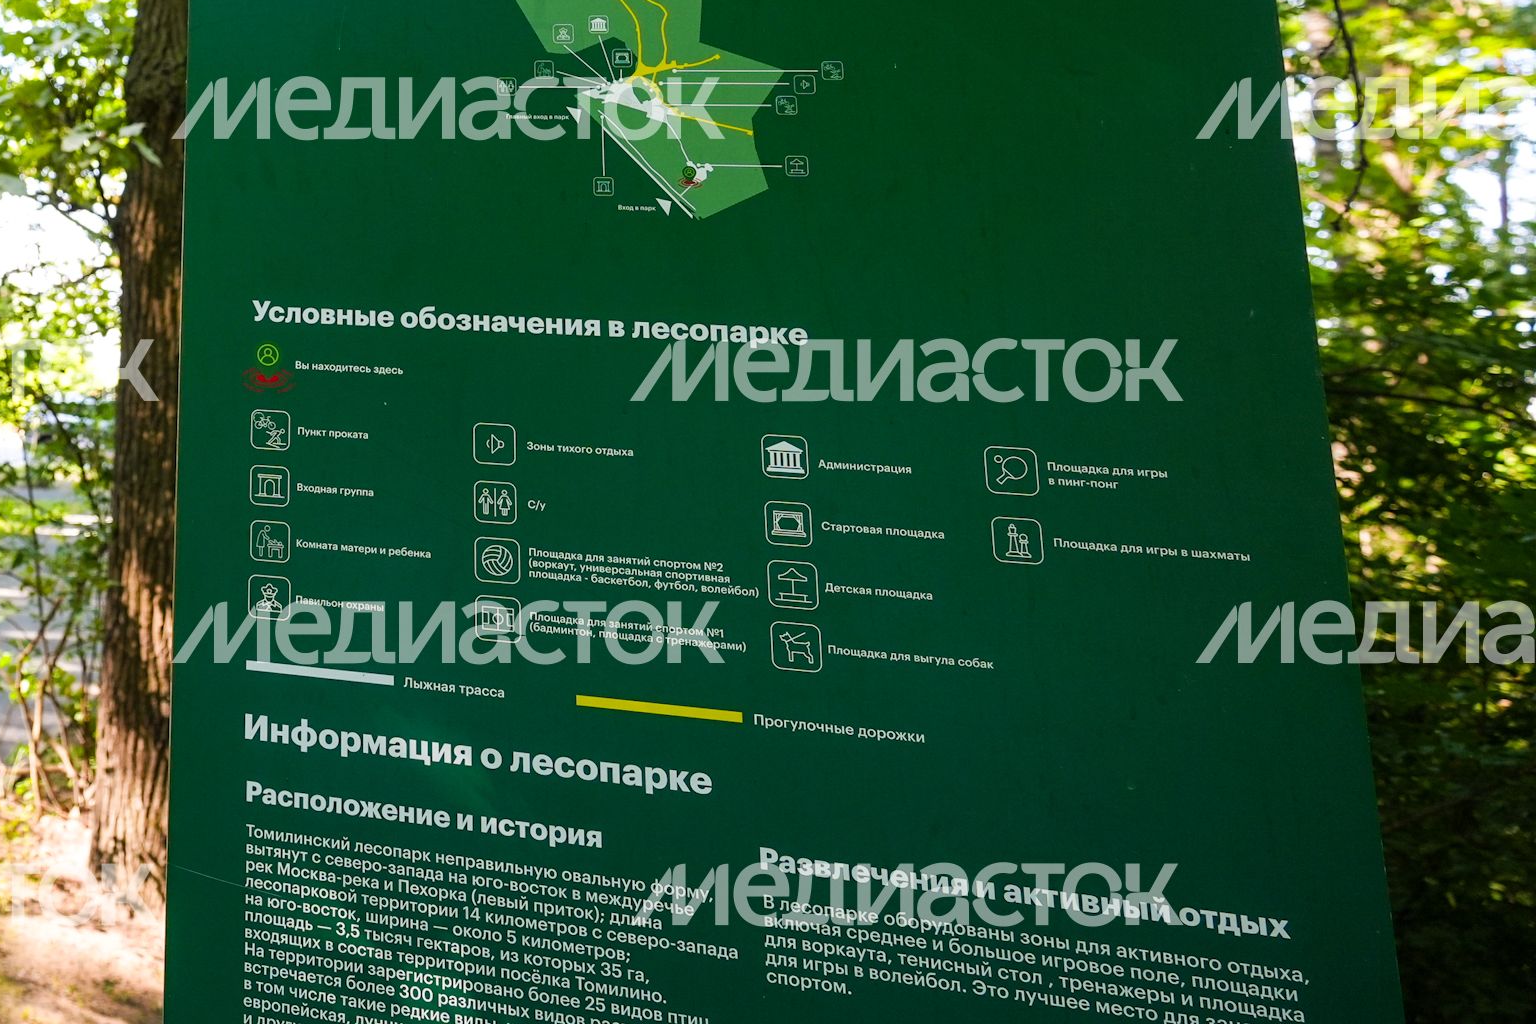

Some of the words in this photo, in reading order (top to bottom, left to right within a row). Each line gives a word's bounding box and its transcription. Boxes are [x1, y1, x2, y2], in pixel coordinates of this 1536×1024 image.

[252, 299, 394, 328] Условные
[400, 306, 601, 336] обозначения
[608, 320, 625, 337] в
[631, 321, 808, 346] лесопарке
[295, 360, 310, 370] Вы
[311, 363, 371, 373] находитесь
[373, 366, 404, 375] здесь
[297, 426, 327, 437] Пункт
[328, 430, 369, 440] проката
[526, 441, 555, 452] Зоны
[556, 445, 593, 454] тихого
[594, 447, 634, 457] отдыха
[818, 459, 912, 474] Администрация
[1046, 461, 1109, 475] Площадка
[1111, 467, 1134, 476] для
[1136, 469, 1168, 479] игры
[296, 482, 338, 494] Входная
[339, 487, 374, 497] группа
[1048, 477, 1055, 485] в
[1057, 478, 1119, 489] пинг-понг
[527, 499, 546, 511] С/у
[821, 521, 883, 534] Стартовая
[885, 527, 945, 540] площадка
[296, 538, 338, 551] Комната
[340, 544, 377, 555] матери
[388, 546, 431, 559] ребенка
[528, 547, 583, 561] Площадка
[584, 554, 604, 563] для
[606, 555, 651, 566] занятий
[652, 559, 701, 570] спортом
[704, 561, 724, 572] №2
[1053, 537, 1117, 552] Площадка
[1120, 544, 1143, 554] для
[1145, 546, 1178, 557] игры
[1180, 549, 1188, 557] в
[1191, 550, 1250, 561] шахматы
[528, 557, 577, 572] (воркаут,
[579, 564, 662, 578] универсальная
[664, 571, 730, 583] спортивная
[528, 570, 582, 582] площадка
[590, 573, 651, 589] баскетбол,
[654, 578, 698, 592] футбол,
[700, 584, 759, 598] волейбол)
[824, 582, 872, 595] Детская
[874, 588, 933, 600] площадка
[295, 595, 344, 608] Павильон
[345, 602, 384, 612] охраны
[530, 612, 584, 626] Площадка
[587, 616, 606, 628] для
[609, 618, 652, 631] занятий
[656, 624, 703, 638] спортом
[706, 628, 724, 638] №1
[530, 622, 596, 637] (бадминтон,
[599, 631, 654, 642] площадка
[666, 637, 746, 651] тренажерами)
[827, 644, 887, 659] Площадка
[889, 652, 911, 662] для
[913, 654, 955, 666] выгула
[957, 657, 994, 669] собак
[403, 676, 455, 693] Лыжная
[458, 685, 505, 698] трасса
[754, 713, 854, 736] Прогулочные
[857, 727, 925, 743] дорожки
[244, 713, 472, 766] Информация
[480, 747, 502, 770] о
[509, 751, 712, 794] лесопарке
[246, 780, 450, 828] Расположение
[456, 812, 473, 832] и
[480, 815, 602, 848] история
[245, 823, 350, 851] Томилинский
[354, 841, 431, 863] лесопарк
[435, 852, 557, 880] неправильную
[561, 870, 646, 892] овальную
[650, 879, 714, 903] форму,
[760, 847, 968, 897] Развлечения
[976, 879, 996, 900] и
[1004, 884, 1172, 924] активный
[1178, 907, 1292, 940] отдых
[244, 877, 357, 903] лесопарковой
[361, 894, 458, 918] территории
[462, 905, 481, 921] 14
[485, 912, 588, 937] километров
[592, 928, 602, 939] с
[606, 930, 738, 960] северо-запада
[764, 916, 842, 938] включая
[764, 895, 775, 909] В
[780, 899, 879, 925] лесопарке
[884, 908, 1014, 942] оборудованы
[1020, 932, 1070, 950] зоны
[1075, 940, 1110, 956] для
[1116, 946, 1222, 971] активного
[1227, 961, 1309, 985] отдыха,
[846, 928, 927, 949] среднее
[948, 937, 1036, 964] и
[1041, 954, 1124, 976] игровое
[1041, 954, 1124, 977] большое
[764, 934, 796, 950] для
[802, 939, 892, 965] воркаута,
[897, 953, 992, 978] тенисный
[997, 967, 1042, 985] стол
[1058, 976, 1175, 1004] тренажеры
[1181, 993, 1193, 1007] и
[1199, 996, 1305, 1023] площадка
[765, 953, 797, 968] для
[803, 958, 848, 976] игры
[854, 965, 864, 978] в
[869, 967, 966, 993] волейбол.
[972, 979, 1009, 999] Это
[1014, 989, 1090, 1011] лучшее
[1096, 1001, 1158, 1021] место
[766, 971, 852, 995] спортом.
[1130, 967, 1185, 988] поле,
[1191, 976, 1298, 1002] площадки
